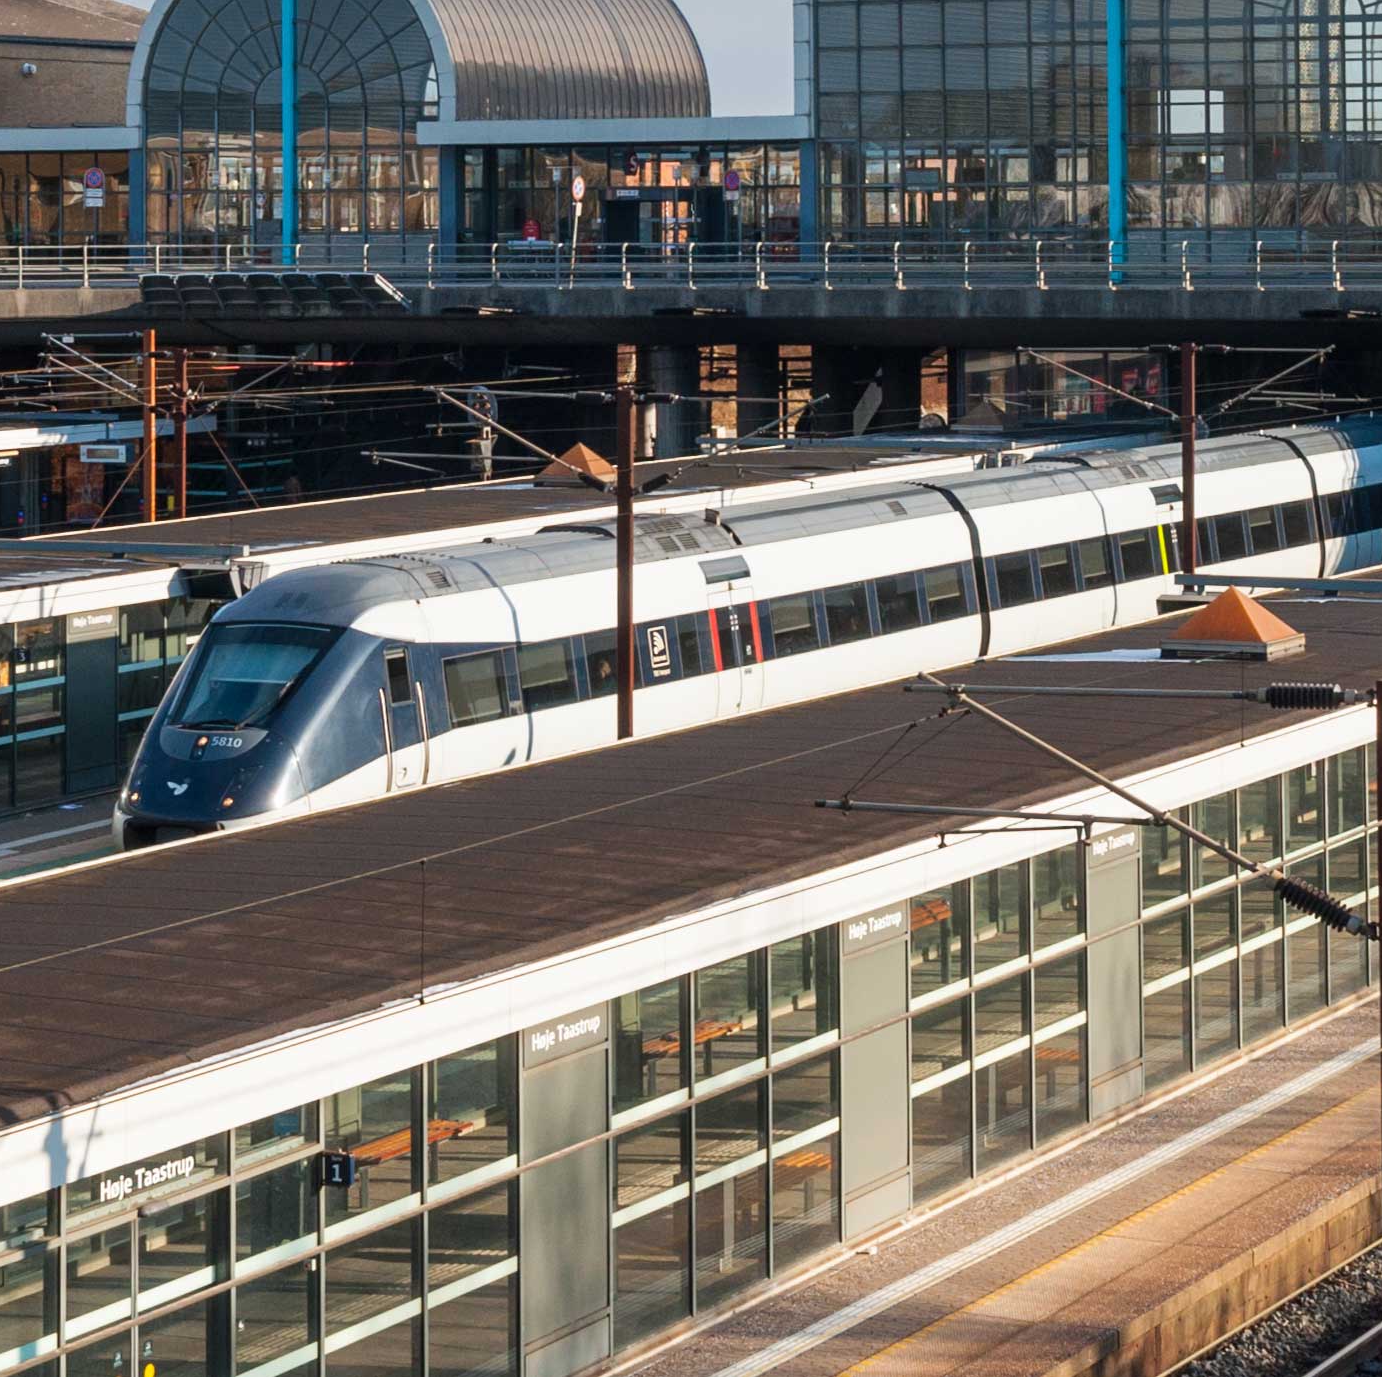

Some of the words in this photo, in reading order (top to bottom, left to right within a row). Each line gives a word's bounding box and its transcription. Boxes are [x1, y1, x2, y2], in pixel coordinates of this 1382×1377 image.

[211, 736, 243, 748] 5810
[531, 1029, 556, 1052] Høje
[557, 1015, 600, 1042] Taastrup
[100, 1175, 133, 1202] Høje
[134, 1155, 195, 1190] Taastrup
[332, 1164, 343, 1182] 1
